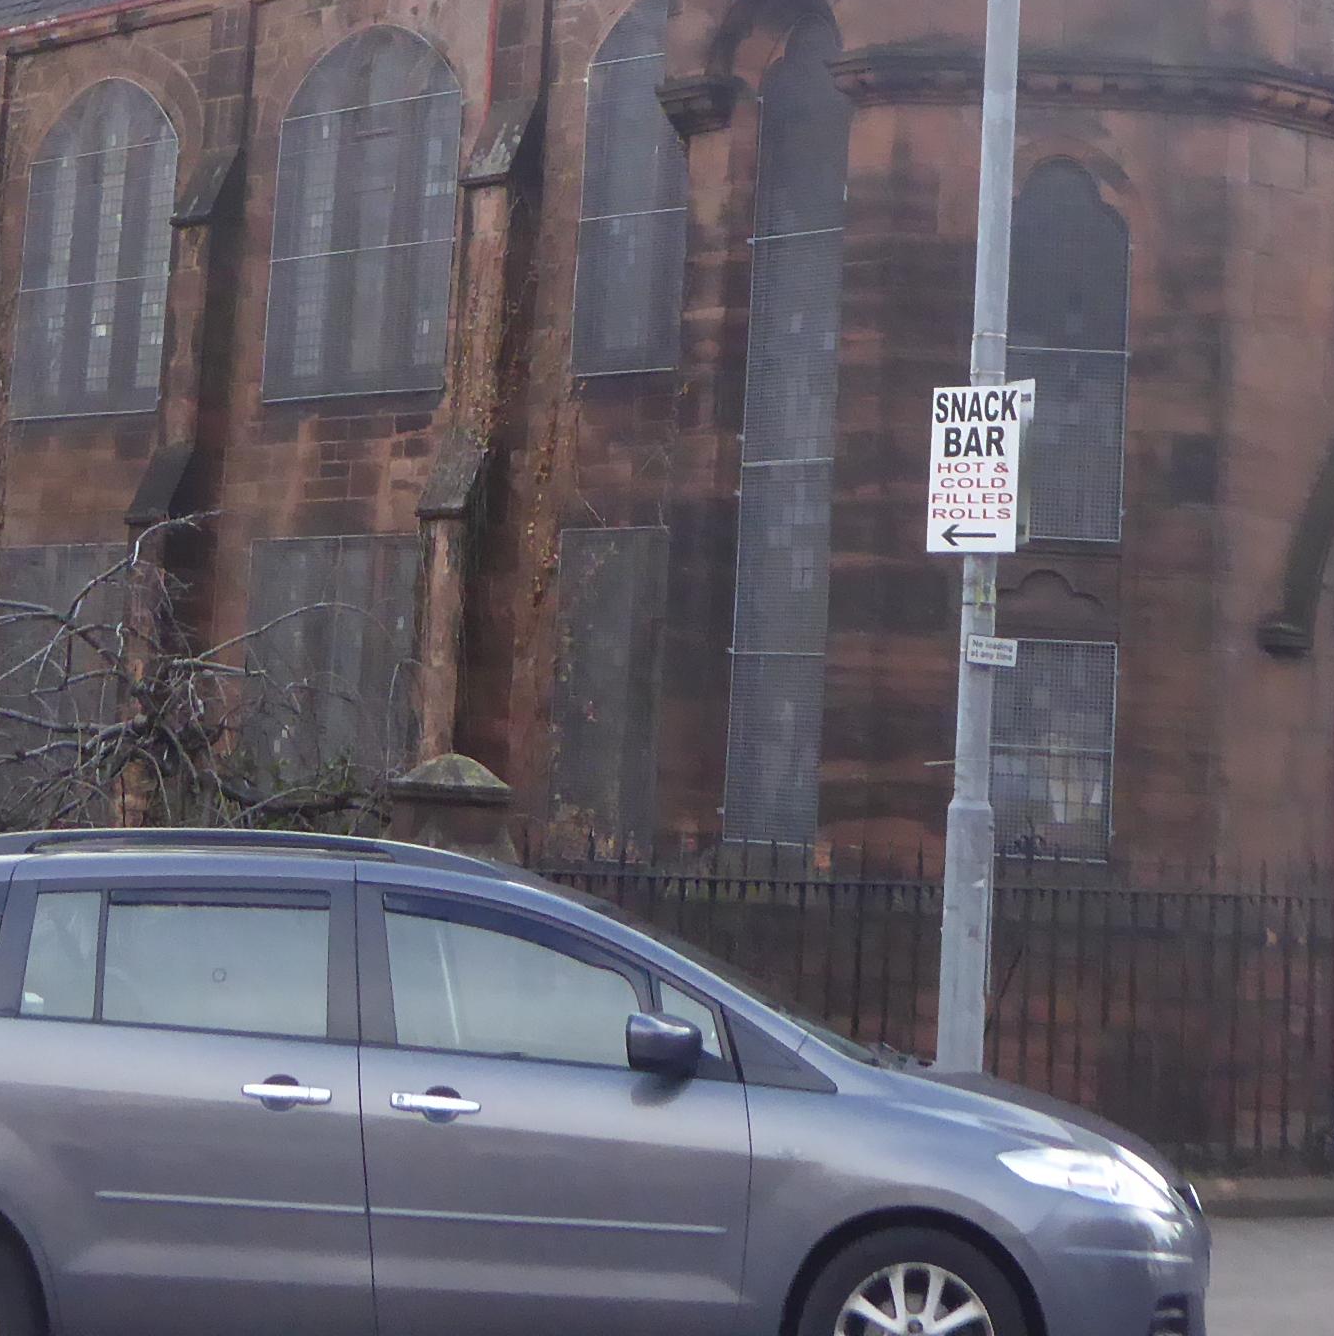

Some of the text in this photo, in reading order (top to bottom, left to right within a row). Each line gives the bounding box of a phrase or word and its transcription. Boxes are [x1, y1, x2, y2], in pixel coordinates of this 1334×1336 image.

[935, 390, 1018, 423] SNACK
[944, 425, 1005, 457] BAR
[937, 461, 1009, 474] HOT &
[940, 477, 1006, 489] COLD
[932, 492, 1013, 505] FILLED
[932, 508, 1011, 520] ROLLS
[972, 639, 984, 648] No
